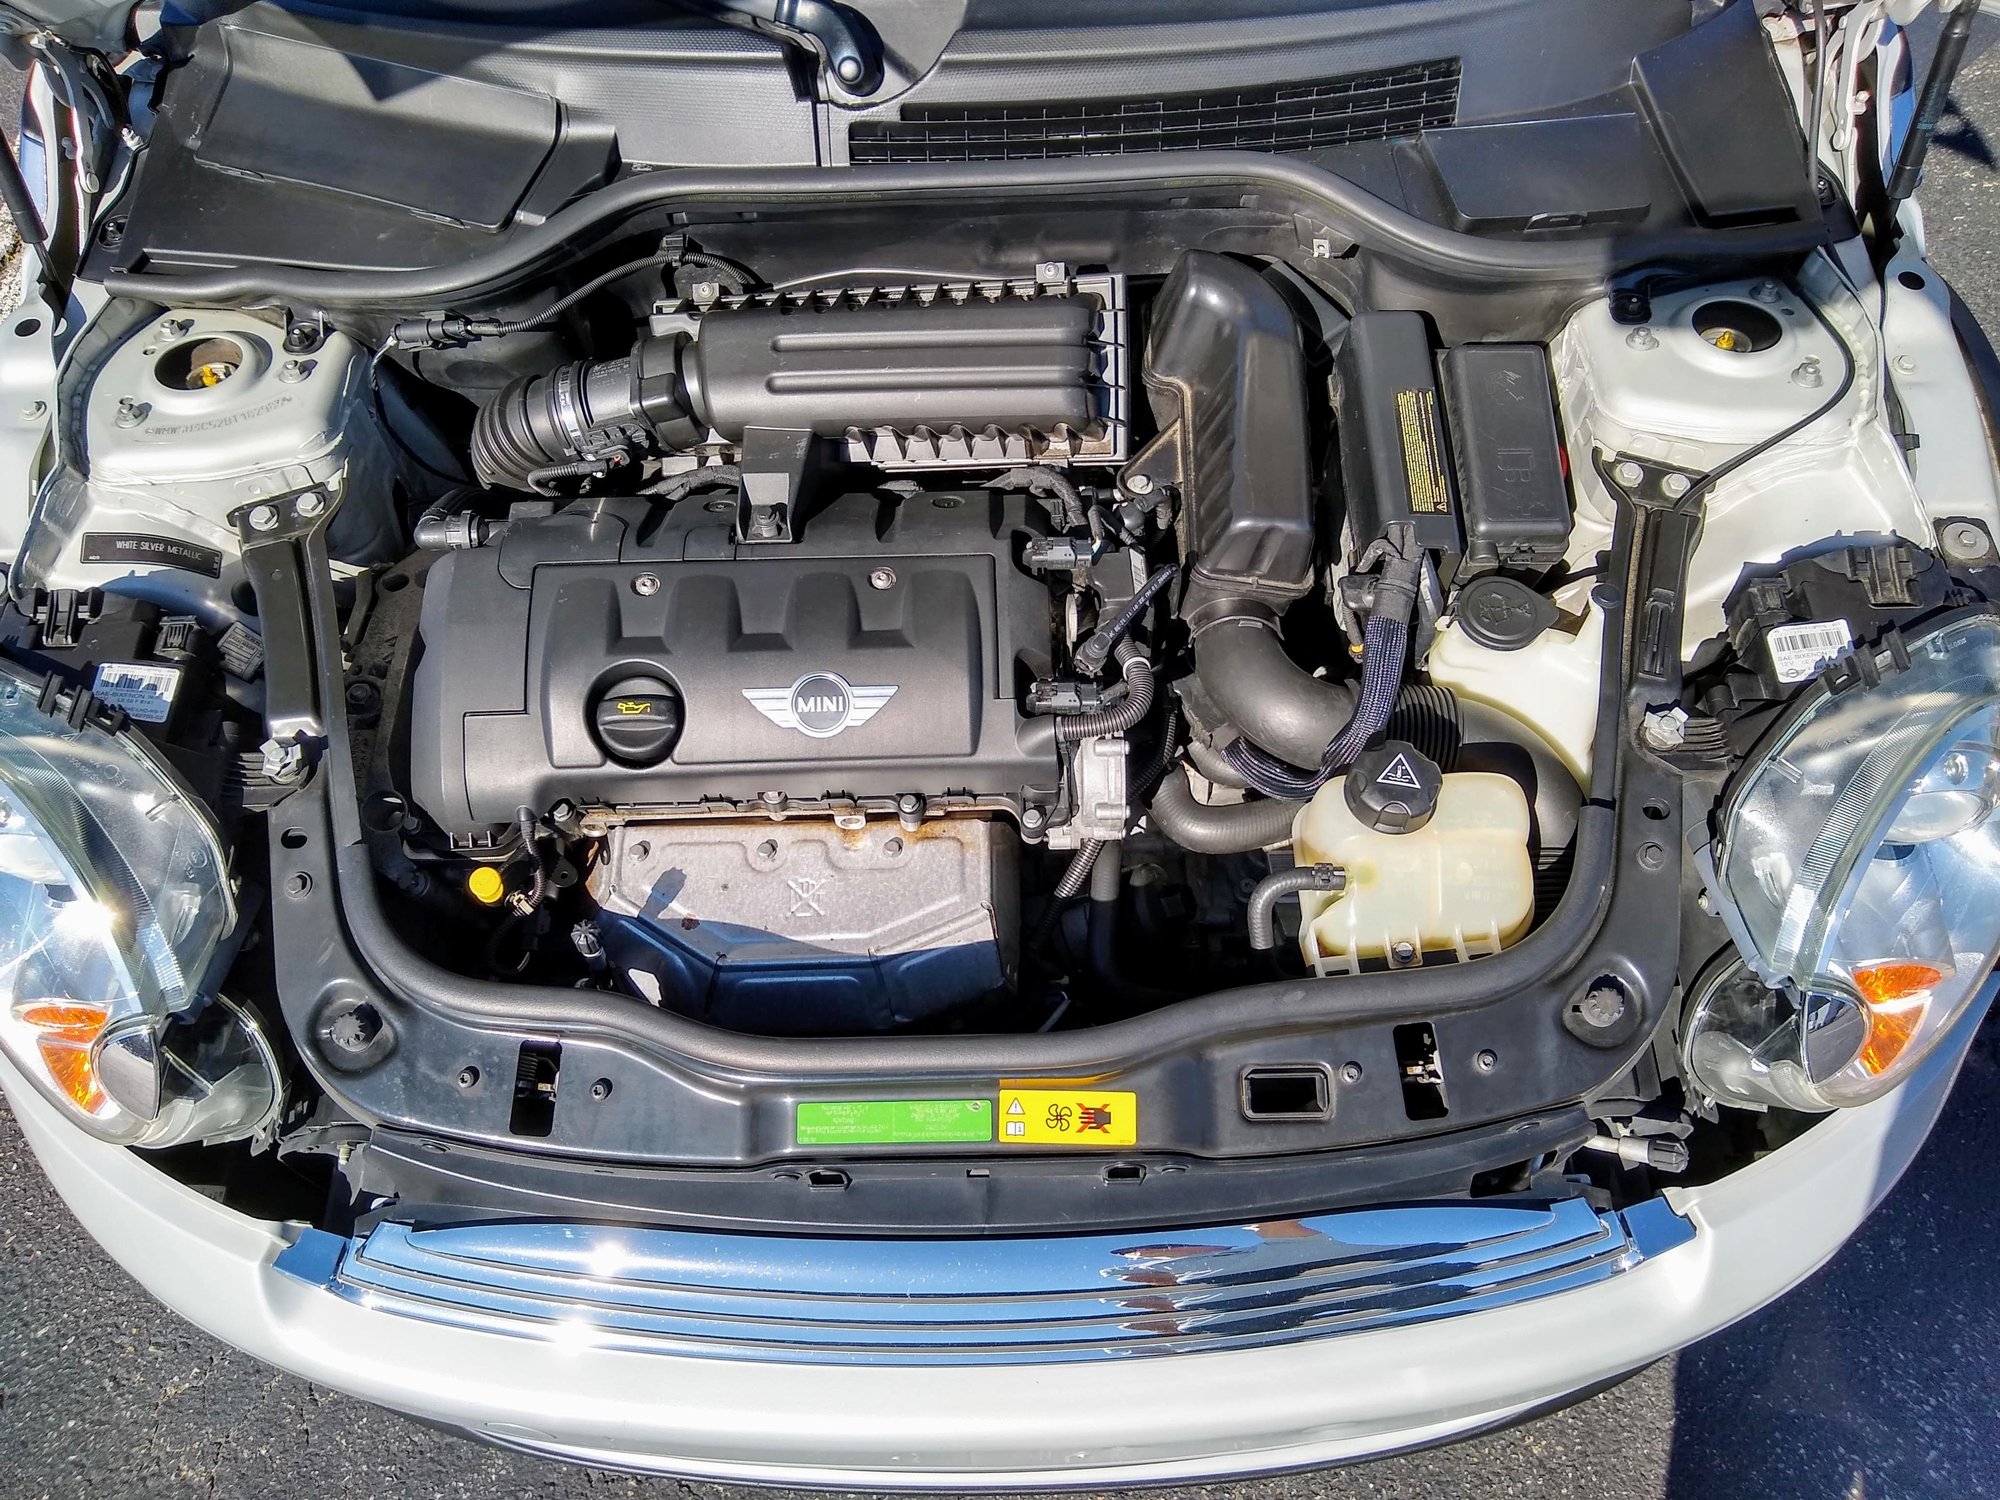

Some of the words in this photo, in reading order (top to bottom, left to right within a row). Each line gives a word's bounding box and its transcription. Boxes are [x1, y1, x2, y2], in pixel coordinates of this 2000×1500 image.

[116, 540, 138, 550] WHITE
[140, 540, 165, 552] SILVER
[167, 545, 203, 561] METALLIC
[797, 695, 844, 713] MINI
